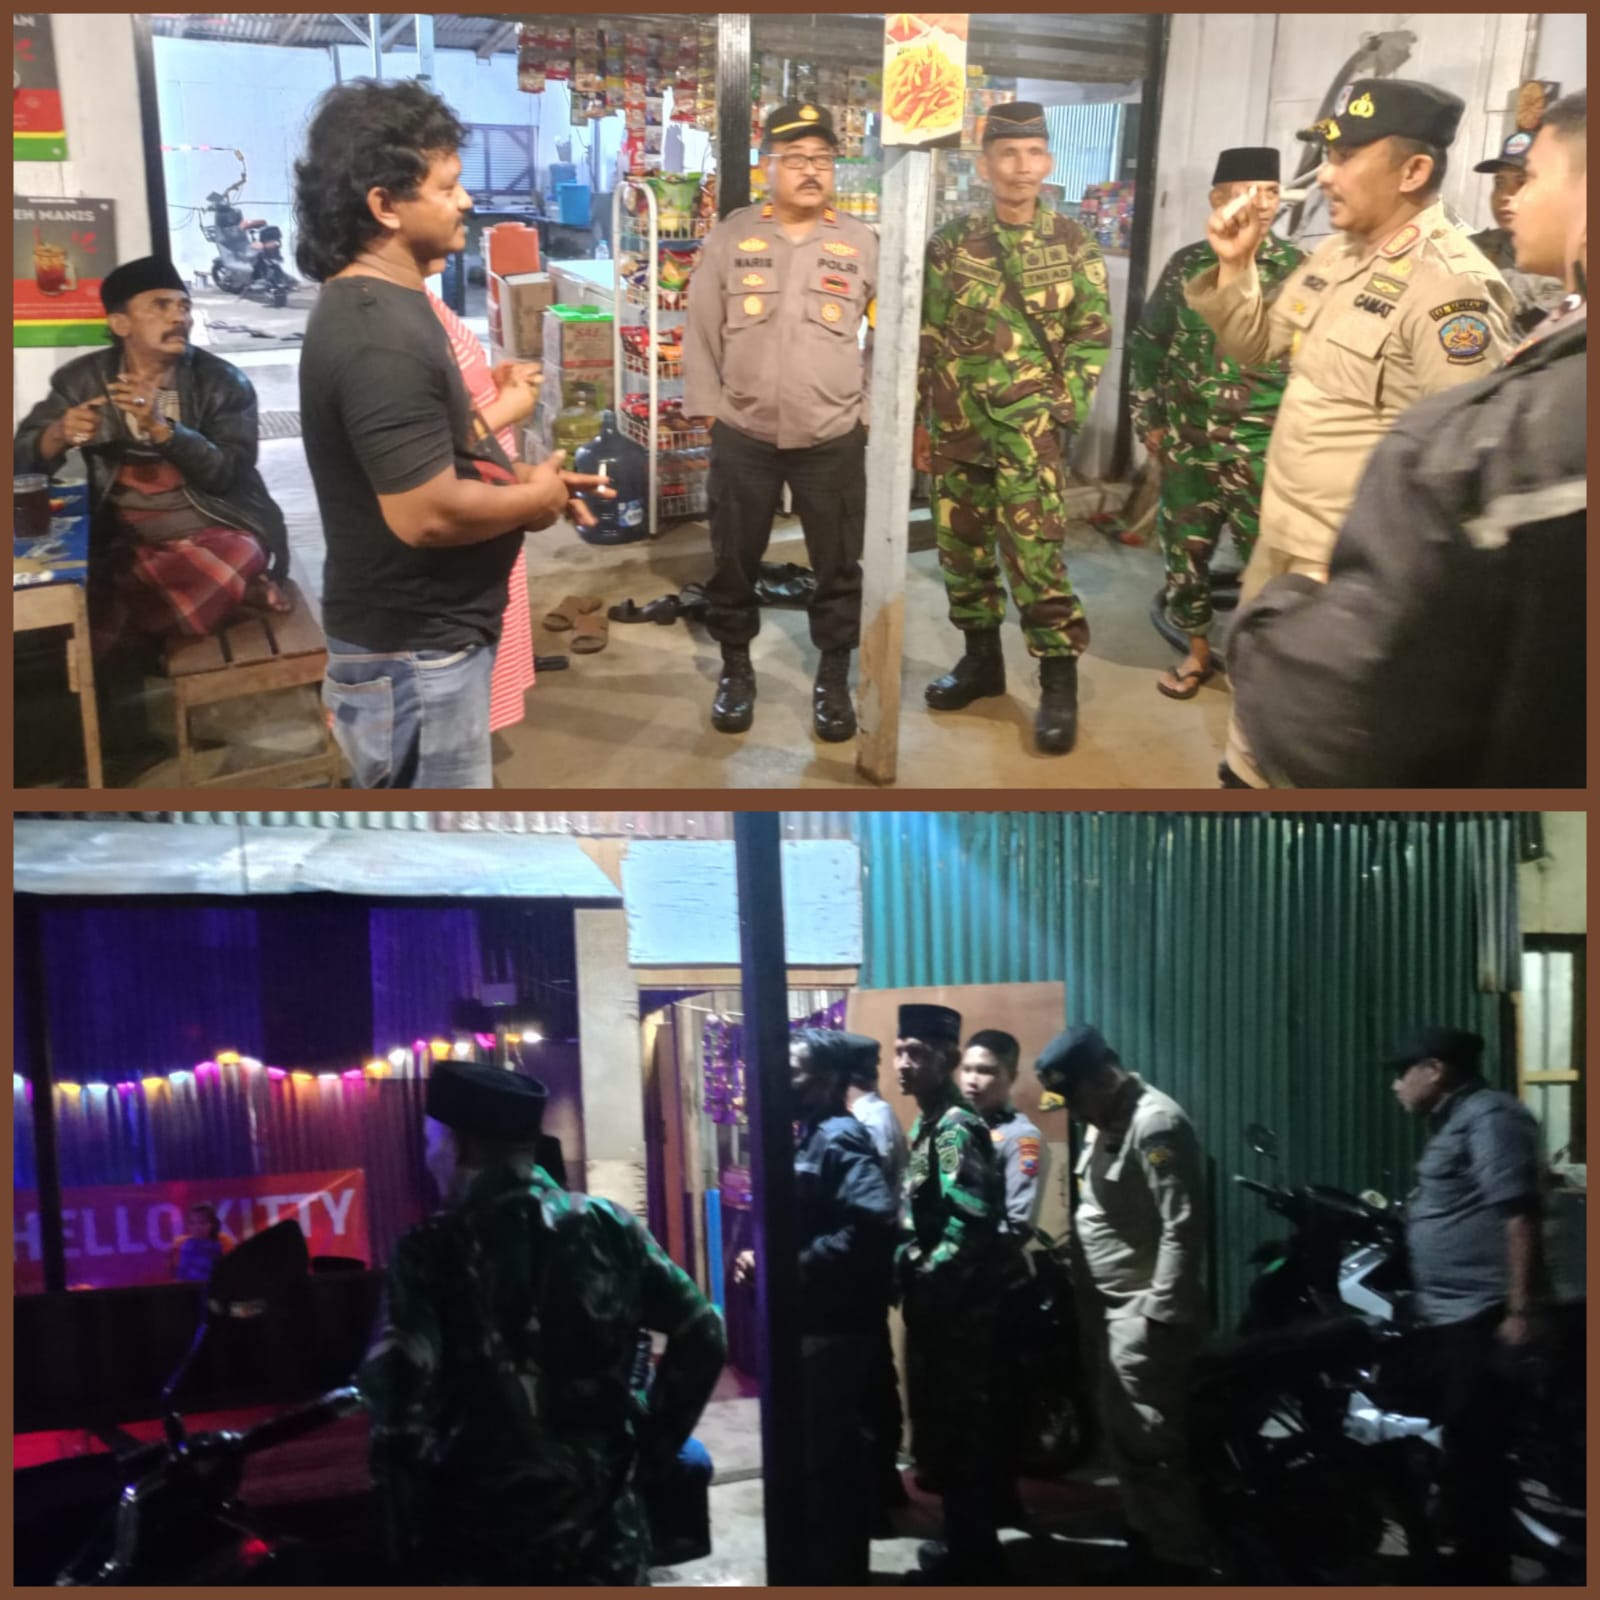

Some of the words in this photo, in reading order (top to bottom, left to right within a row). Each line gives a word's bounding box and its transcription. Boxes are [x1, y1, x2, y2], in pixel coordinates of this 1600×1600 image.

[38, 210, 96, 222] MANIS
[817, 257, 858, 275] POLRI
[1053, 269, 1069, 279] AD
[1354, 293, 1396, 319] CAMAT
[14, 1204, 184, 1261] HELLO
